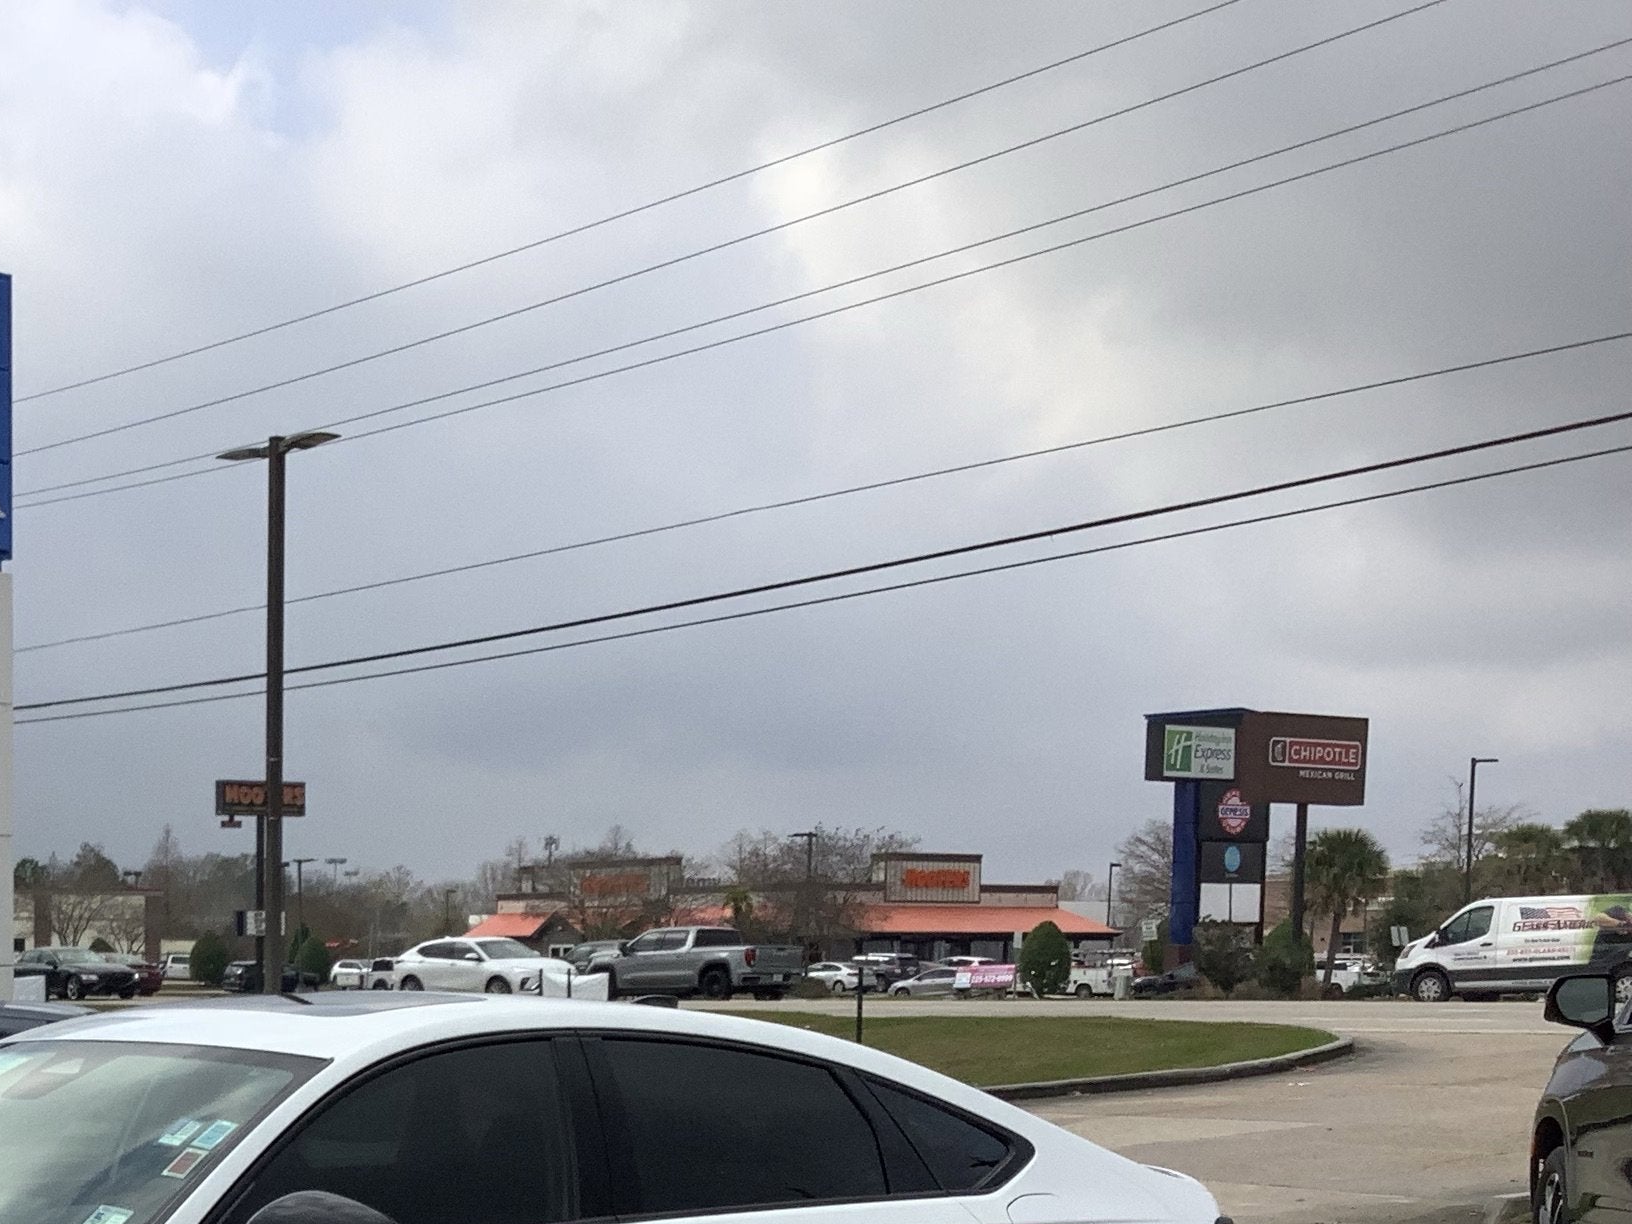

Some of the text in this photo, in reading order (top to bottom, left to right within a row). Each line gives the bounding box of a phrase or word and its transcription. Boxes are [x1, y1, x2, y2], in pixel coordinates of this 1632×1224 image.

[1194, 744, 1232, 763] Express
[1290, 745, 1357, 763] CHIPOTLE
[1299, 769, 1356, 781] MEXICAN GRILL
